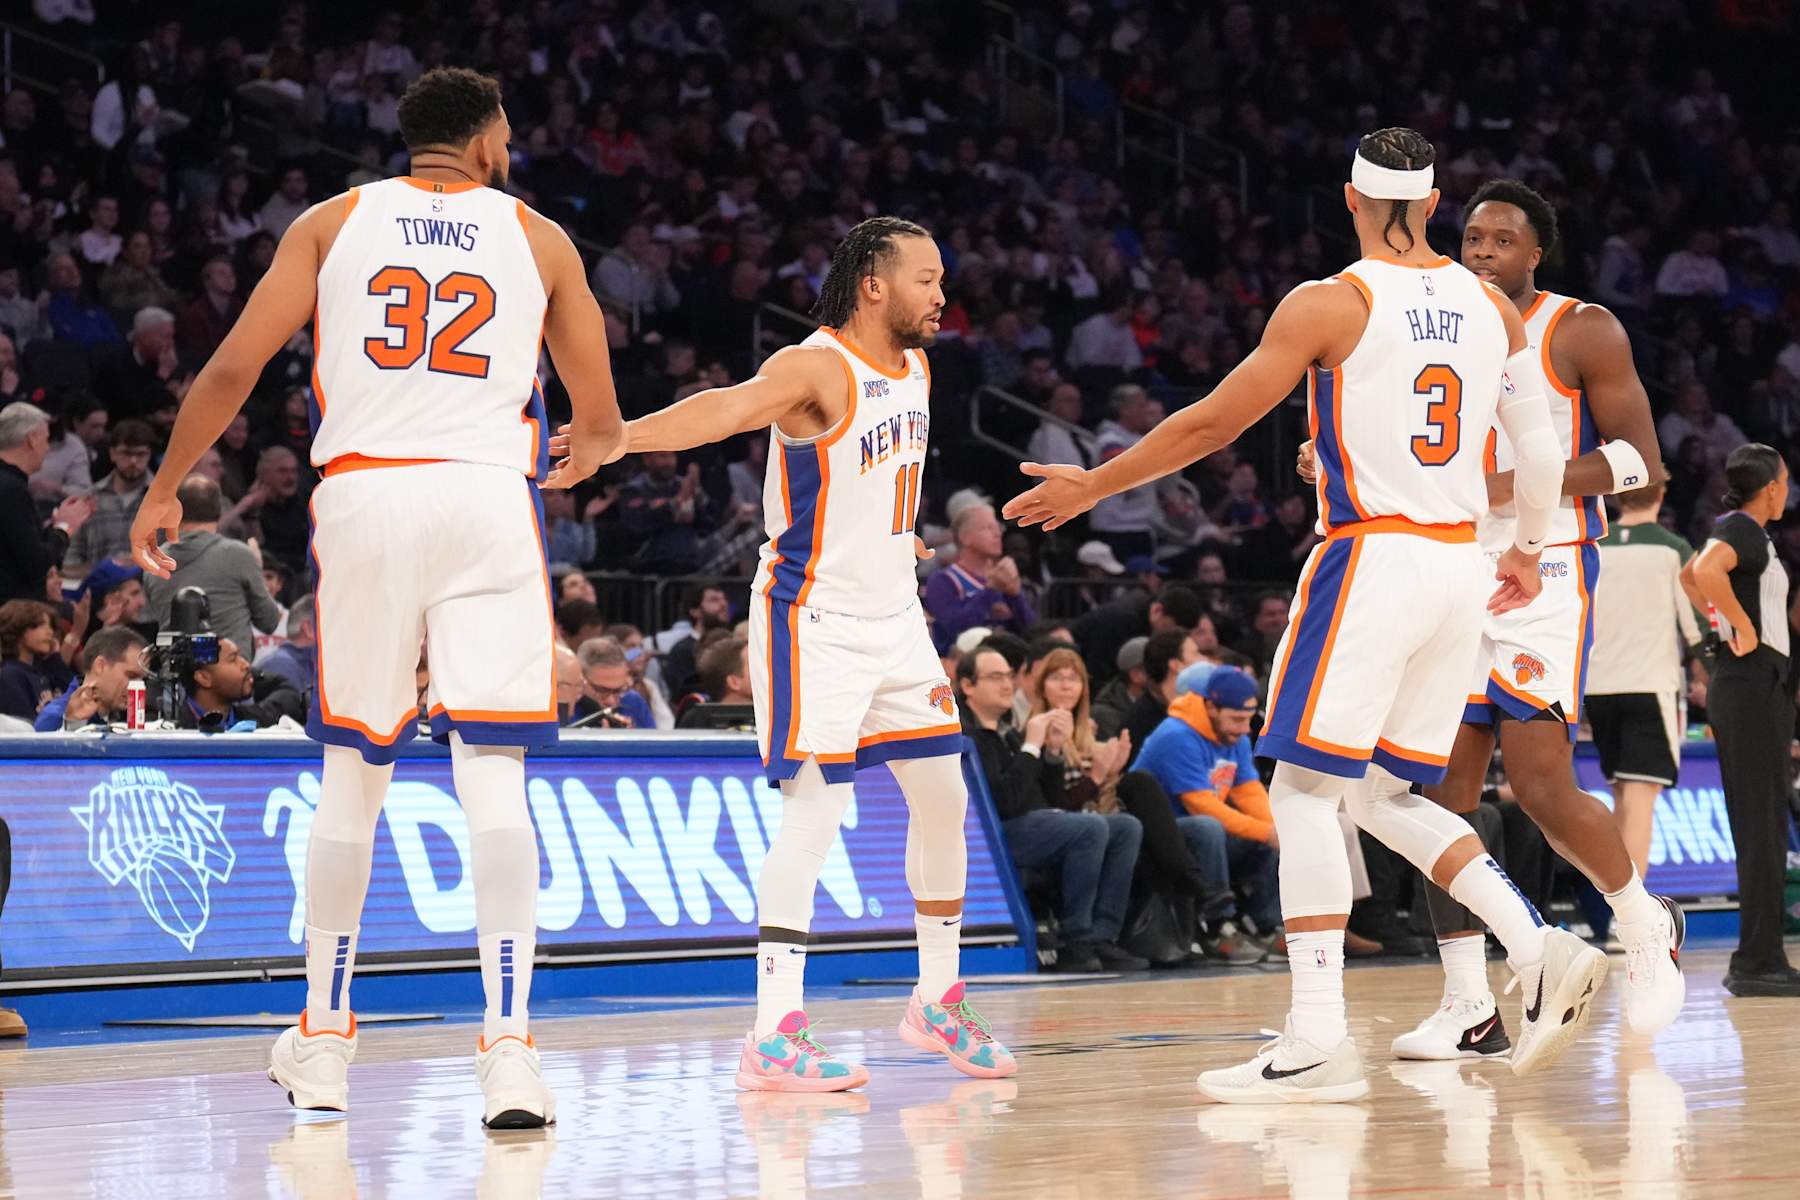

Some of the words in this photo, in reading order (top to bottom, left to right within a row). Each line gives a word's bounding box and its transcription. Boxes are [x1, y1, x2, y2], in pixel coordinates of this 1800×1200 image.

[396, 217, 479, 252] TOWNS
[364, 265, 496, 379] 32
[1405, 308, 1463, 344] HART
[863, 379, 890, 398] NYC
[1410, 363, 1463, 467] 3
[859, 414, 902, 475] NEW
[907, 410, 929, 450] YOR
[891, 462, 920, 535] 11
[1538, 561, 1568, 578] NYC
[88, 781, 236, 886] KNICKS
